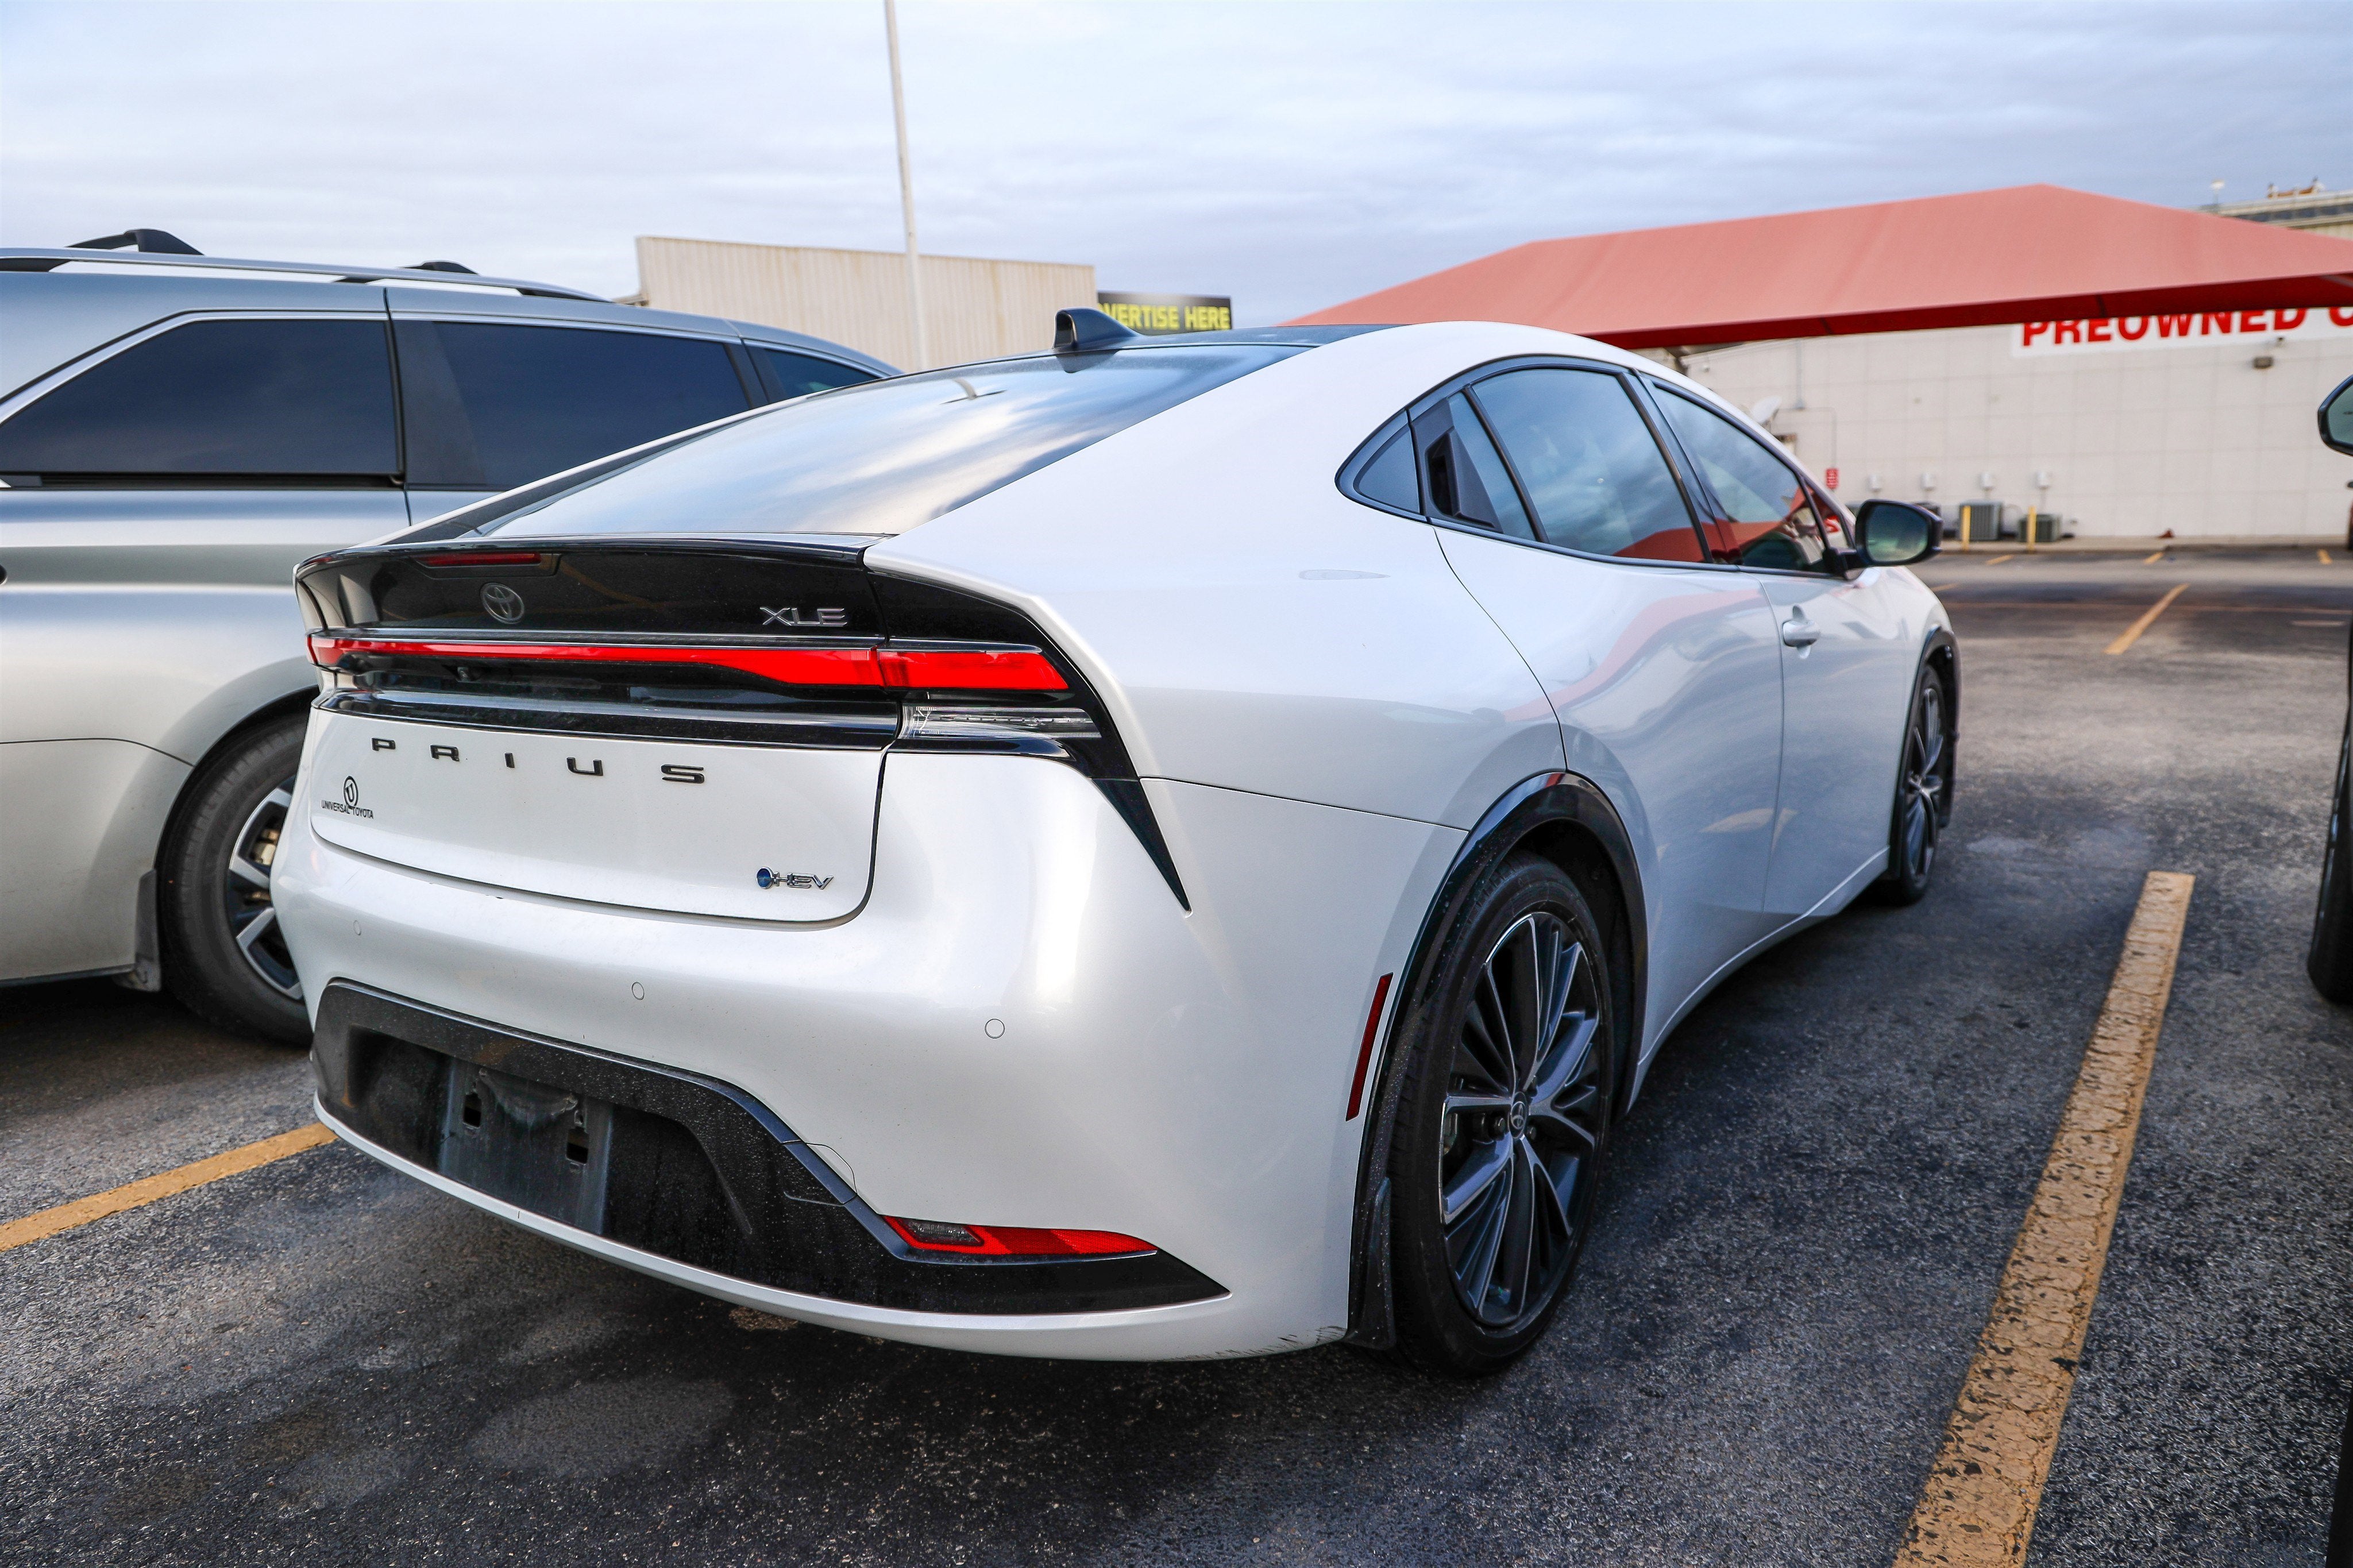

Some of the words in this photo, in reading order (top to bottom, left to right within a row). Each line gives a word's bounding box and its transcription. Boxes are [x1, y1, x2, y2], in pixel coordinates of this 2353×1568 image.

[1098, 303, 1179, 330] VERTISE
[1184, 306, 1230, 330] HERE
[2023, 307, 2307, 346] PREOWNED
[759, 607, 847, 627] XLE
[371, 737, 705, 784] PRIUS
[321, 799, 351, 814] UNIVERSAL
[352, 806, 375, 820] TOYOTA
[773, 871, 835, 890] HEV
